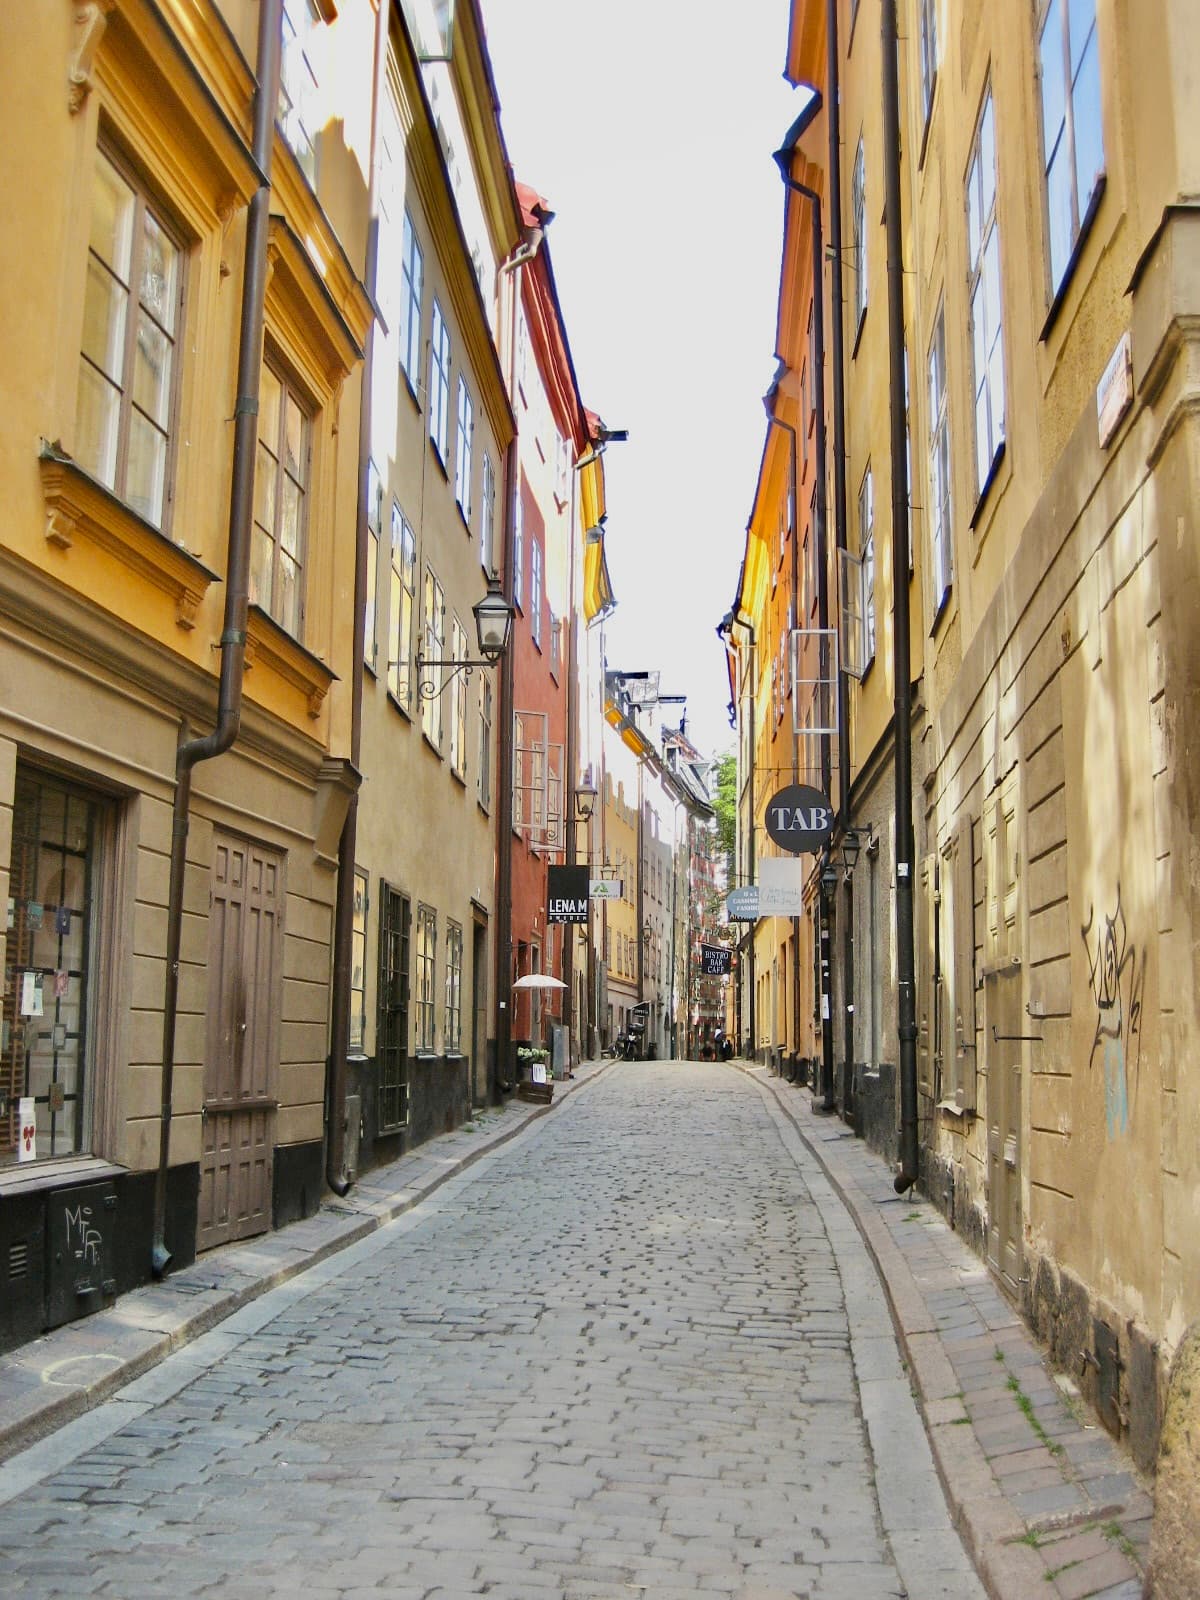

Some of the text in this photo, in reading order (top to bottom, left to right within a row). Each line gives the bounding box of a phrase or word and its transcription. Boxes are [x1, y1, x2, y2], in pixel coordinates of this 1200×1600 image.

[771, 807, 828, 831] TAB
[549, 899, 587, 913] LENA M
[705, 951, 729, 959] BISTRO
